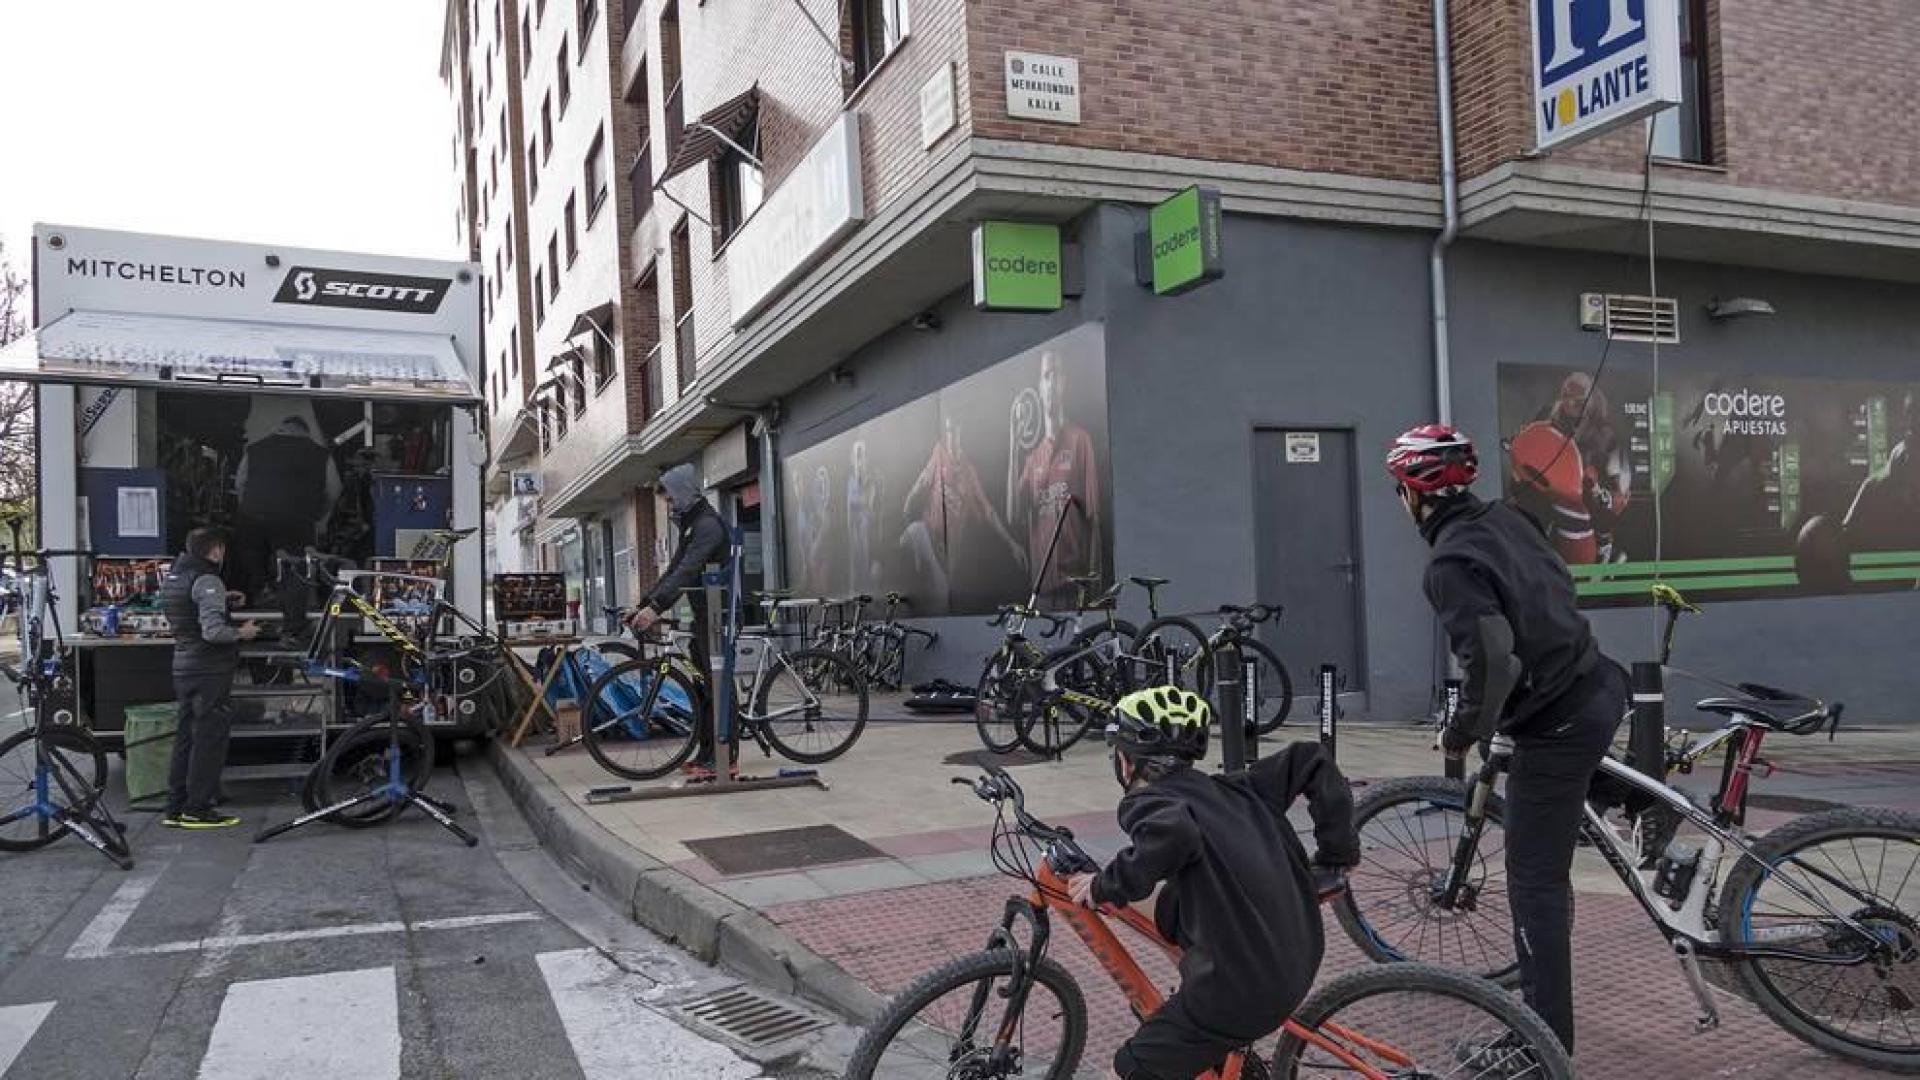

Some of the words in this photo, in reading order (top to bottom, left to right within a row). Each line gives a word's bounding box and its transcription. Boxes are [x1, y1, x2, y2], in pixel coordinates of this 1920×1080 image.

[1031, 63, 1064, 78] CALLE
[1542, 54, 1648, 133] VOLANTE
[1155, 225, 1199, 259] codere
[67, 257, 246, 288] MITCHELTON
[989, 256, 1058, 275] codere
[321, 282, 435, 302] SCOTT
[1704, 387, 1785, 418] codere
[1723, 419, 1787, 436] APUESTAS
